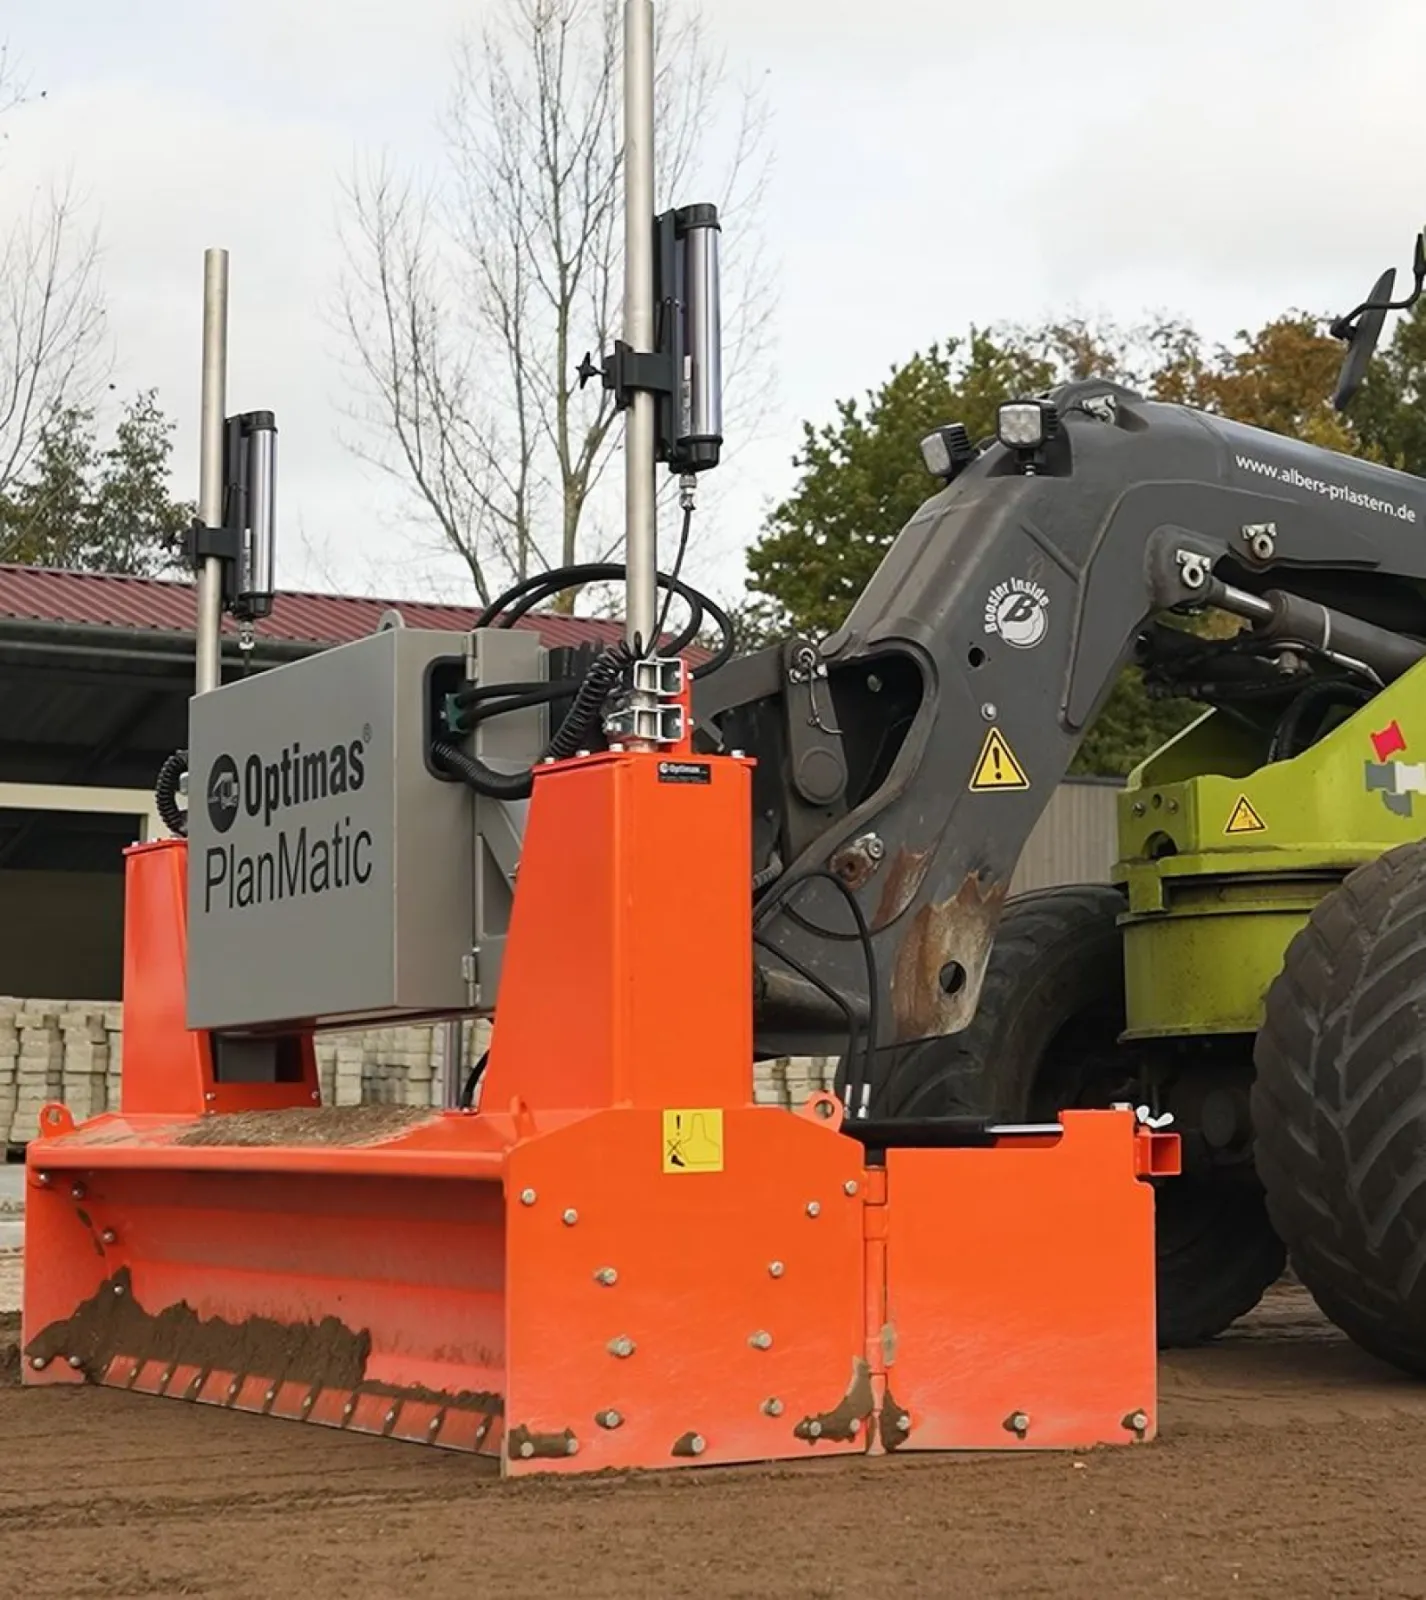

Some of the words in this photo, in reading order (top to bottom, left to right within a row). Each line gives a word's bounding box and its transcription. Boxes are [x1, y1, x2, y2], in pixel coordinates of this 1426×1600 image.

[984, 581, 1010, 634] Booster
[1010, 576, 1049, 607] Inside
[205, 816, 372, 913] PlanMatic
